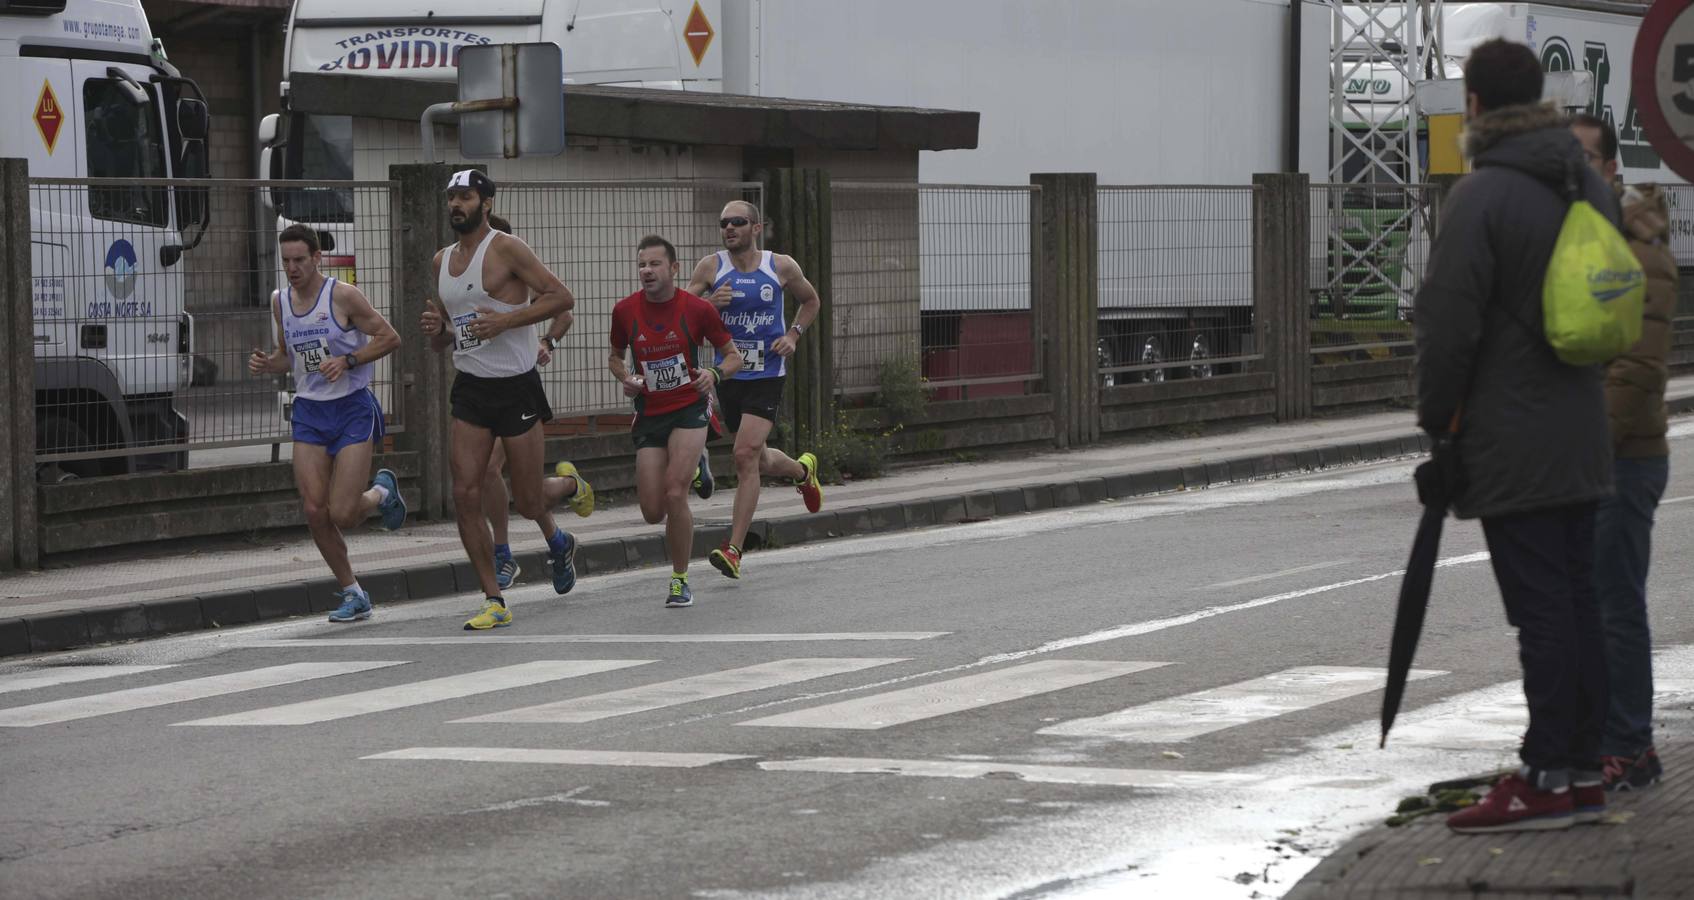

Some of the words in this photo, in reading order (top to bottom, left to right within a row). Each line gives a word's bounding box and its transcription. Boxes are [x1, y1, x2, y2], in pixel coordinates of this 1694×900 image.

[336, 27, 491, 49] TRANSPORTES
[43, 98, 54, 112] LU
[88, 302, 111, 318] COSTA
[115, 301, 138, 318] NORTE
[752, 311, 775, 326] bike
[301, 350, 321, 362] 244
[654, 366, 677, 383] 202
